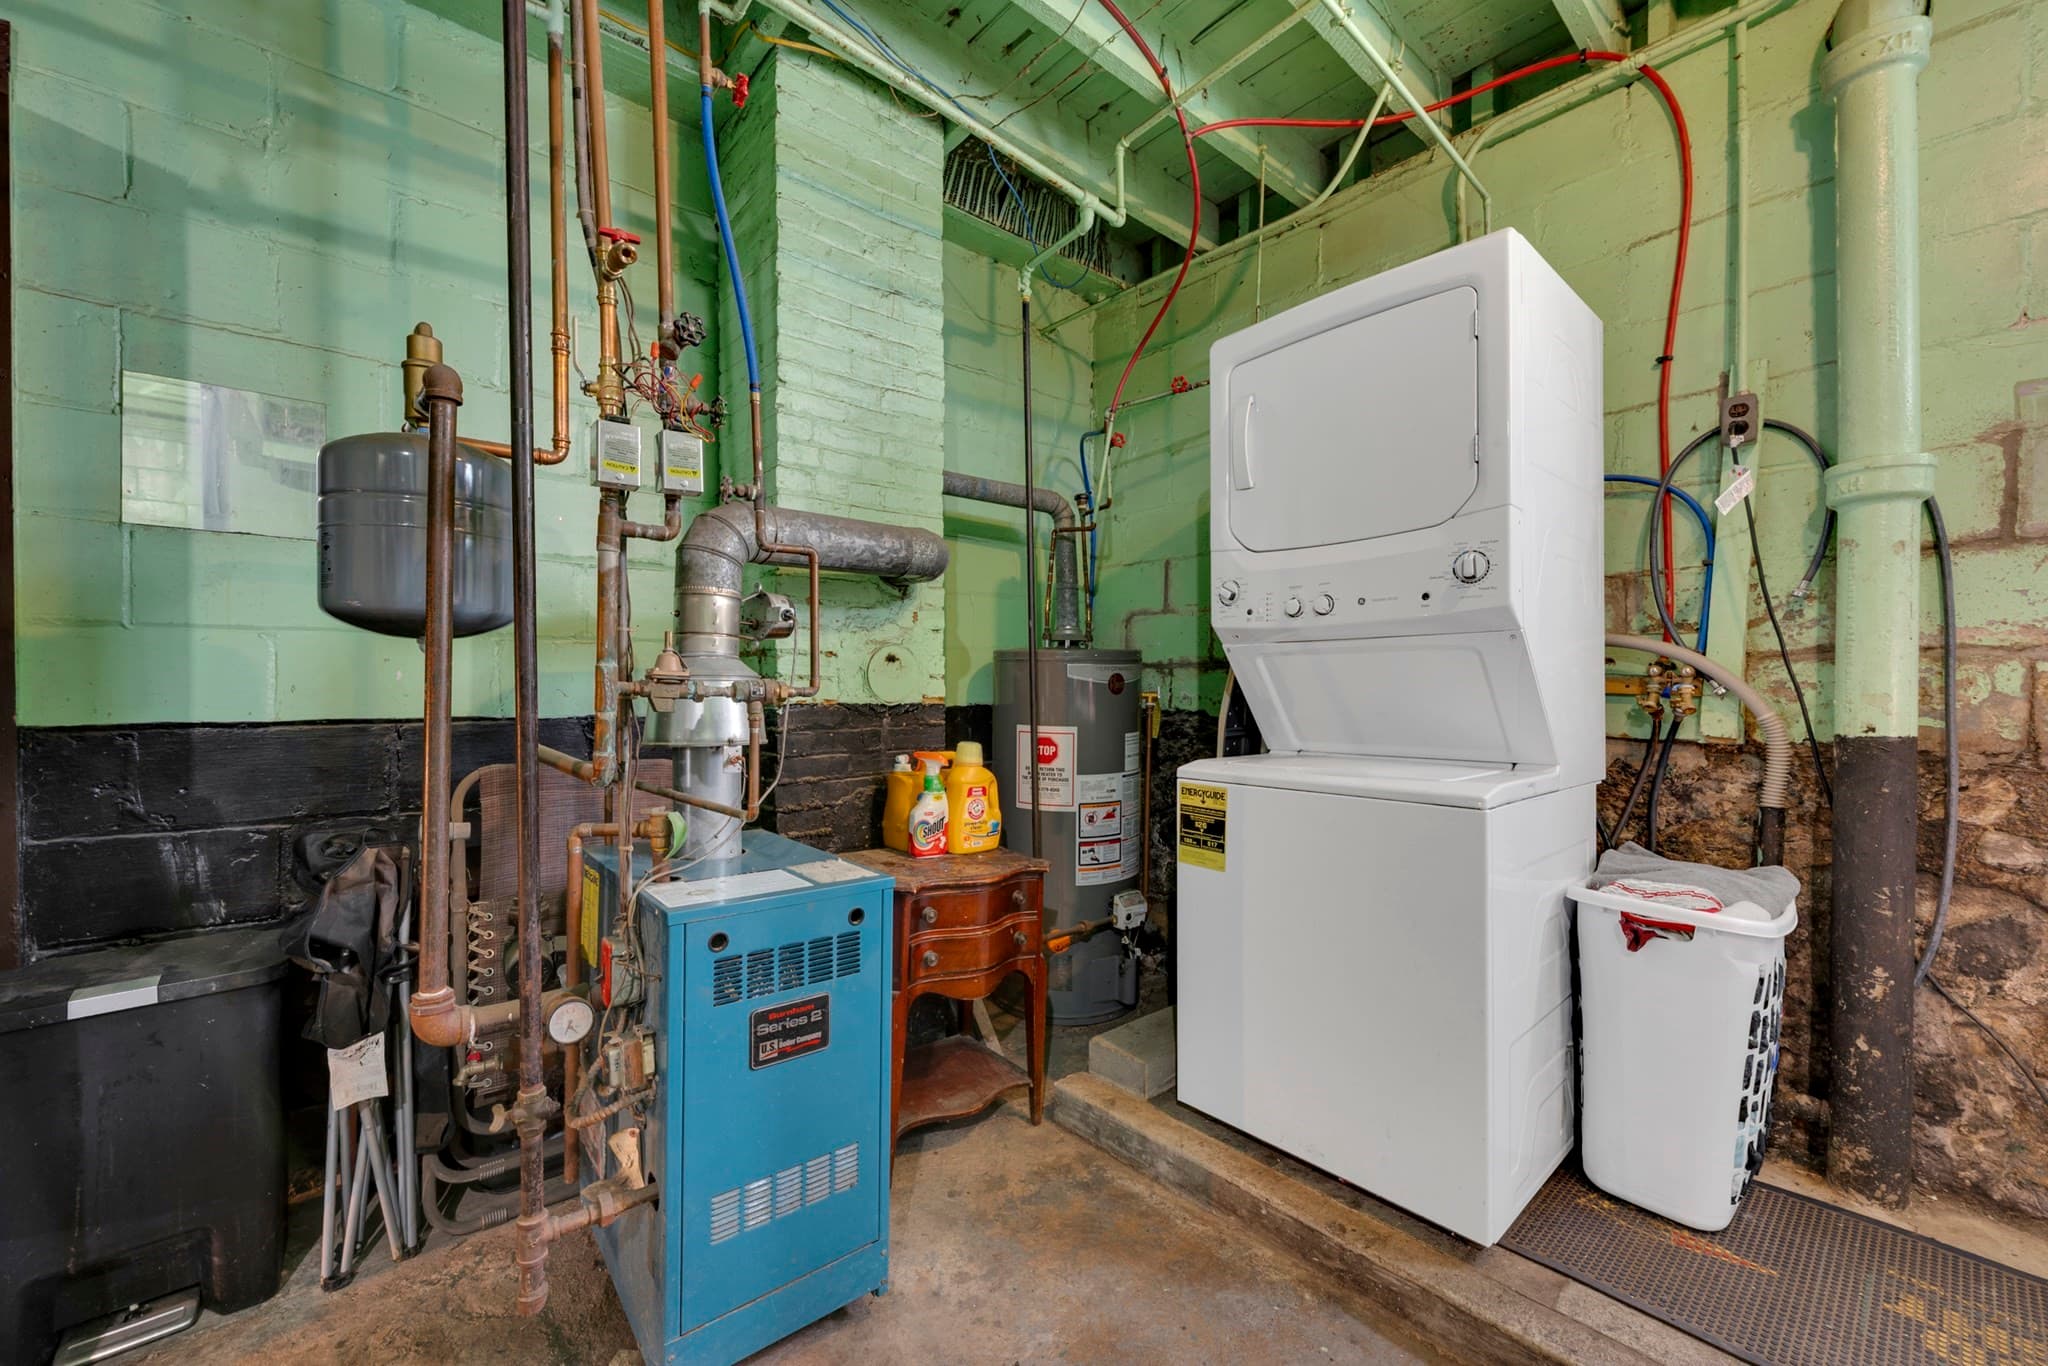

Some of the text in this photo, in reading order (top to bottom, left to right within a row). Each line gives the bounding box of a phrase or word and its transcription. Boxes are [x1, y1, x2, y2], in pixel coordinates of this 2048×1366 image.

[1037, 746, 1056, 756] TOP
[922, 816, 946, 838] SHOUT
[756, 1009, 823, 1036] Series 2
[768, 1004, 815, 1021] Burnham
[761, 1042, 777, 1054] U.S.
[797, 1031, 822, 1044] Company
